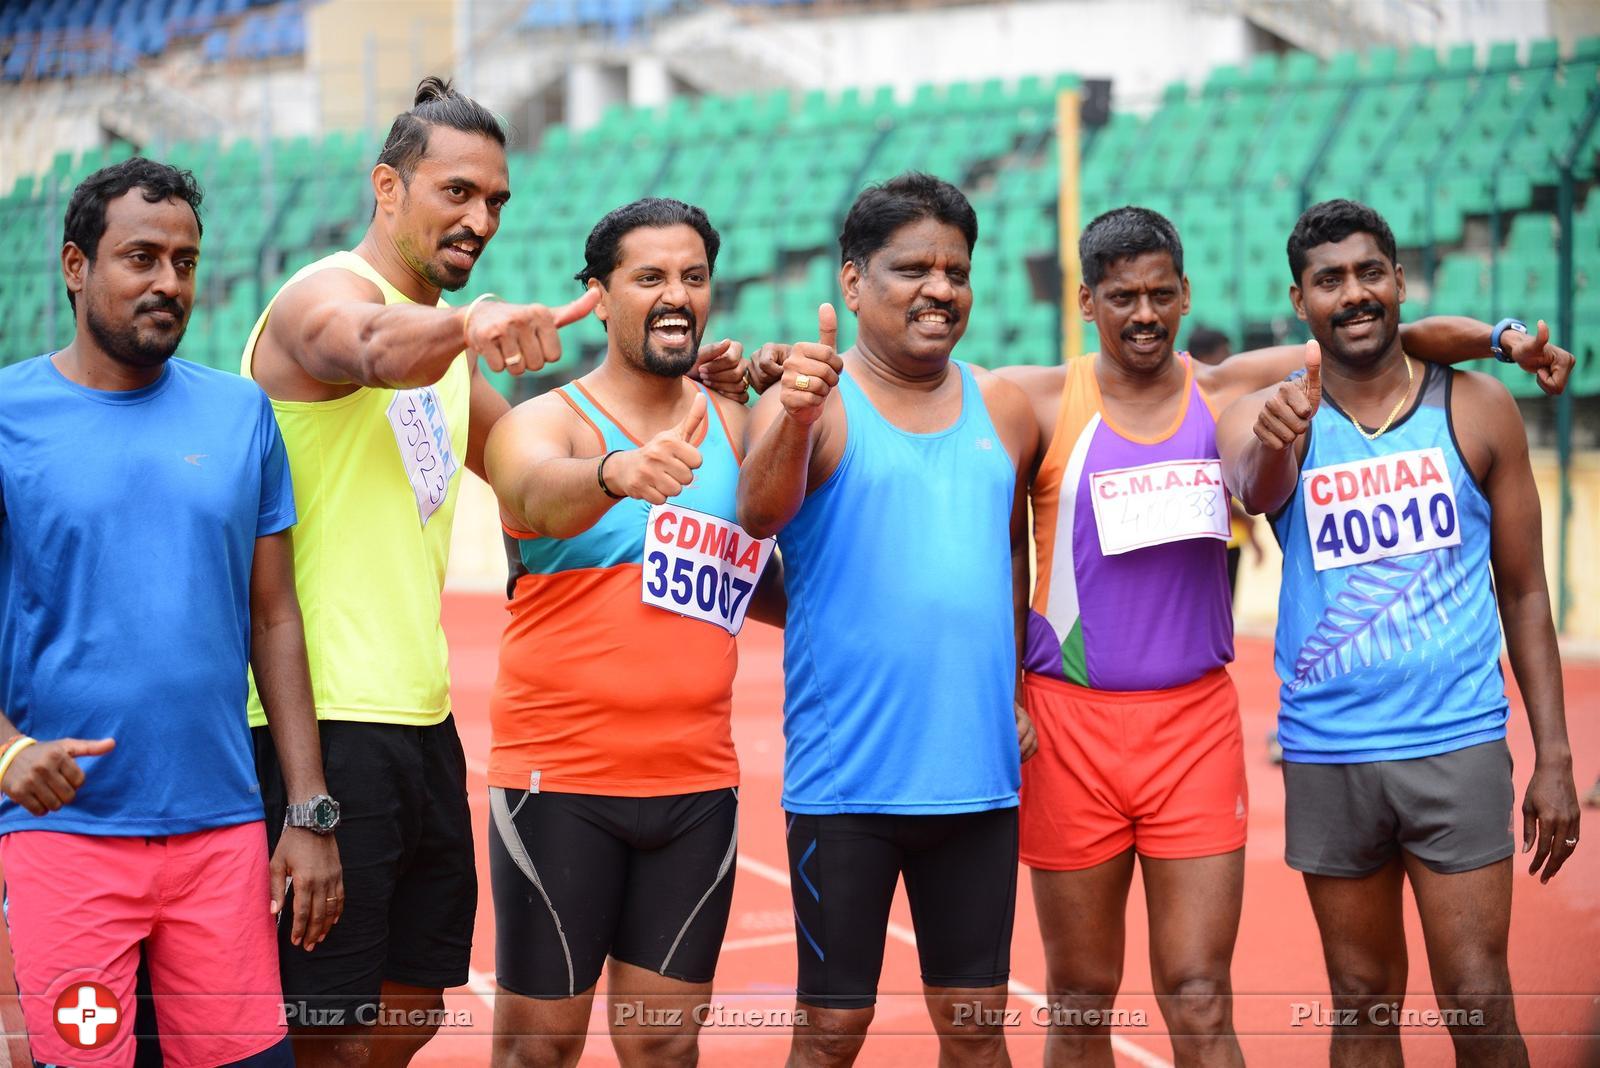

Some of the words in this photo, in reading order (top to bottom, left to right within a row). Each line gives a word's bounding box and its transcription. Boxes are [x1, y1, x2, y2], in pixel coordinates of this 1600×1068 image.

[400, 397, 445, 505] 35023
[1310, 456, 1443, 506] CDMAA
[1098, 469, 1220, 500] C.M.A.A.
[654, 511, 761, 574] CDMAA
[1316, 492, 1455, 558] 40010
[647, 550, 753, 624] 35007
